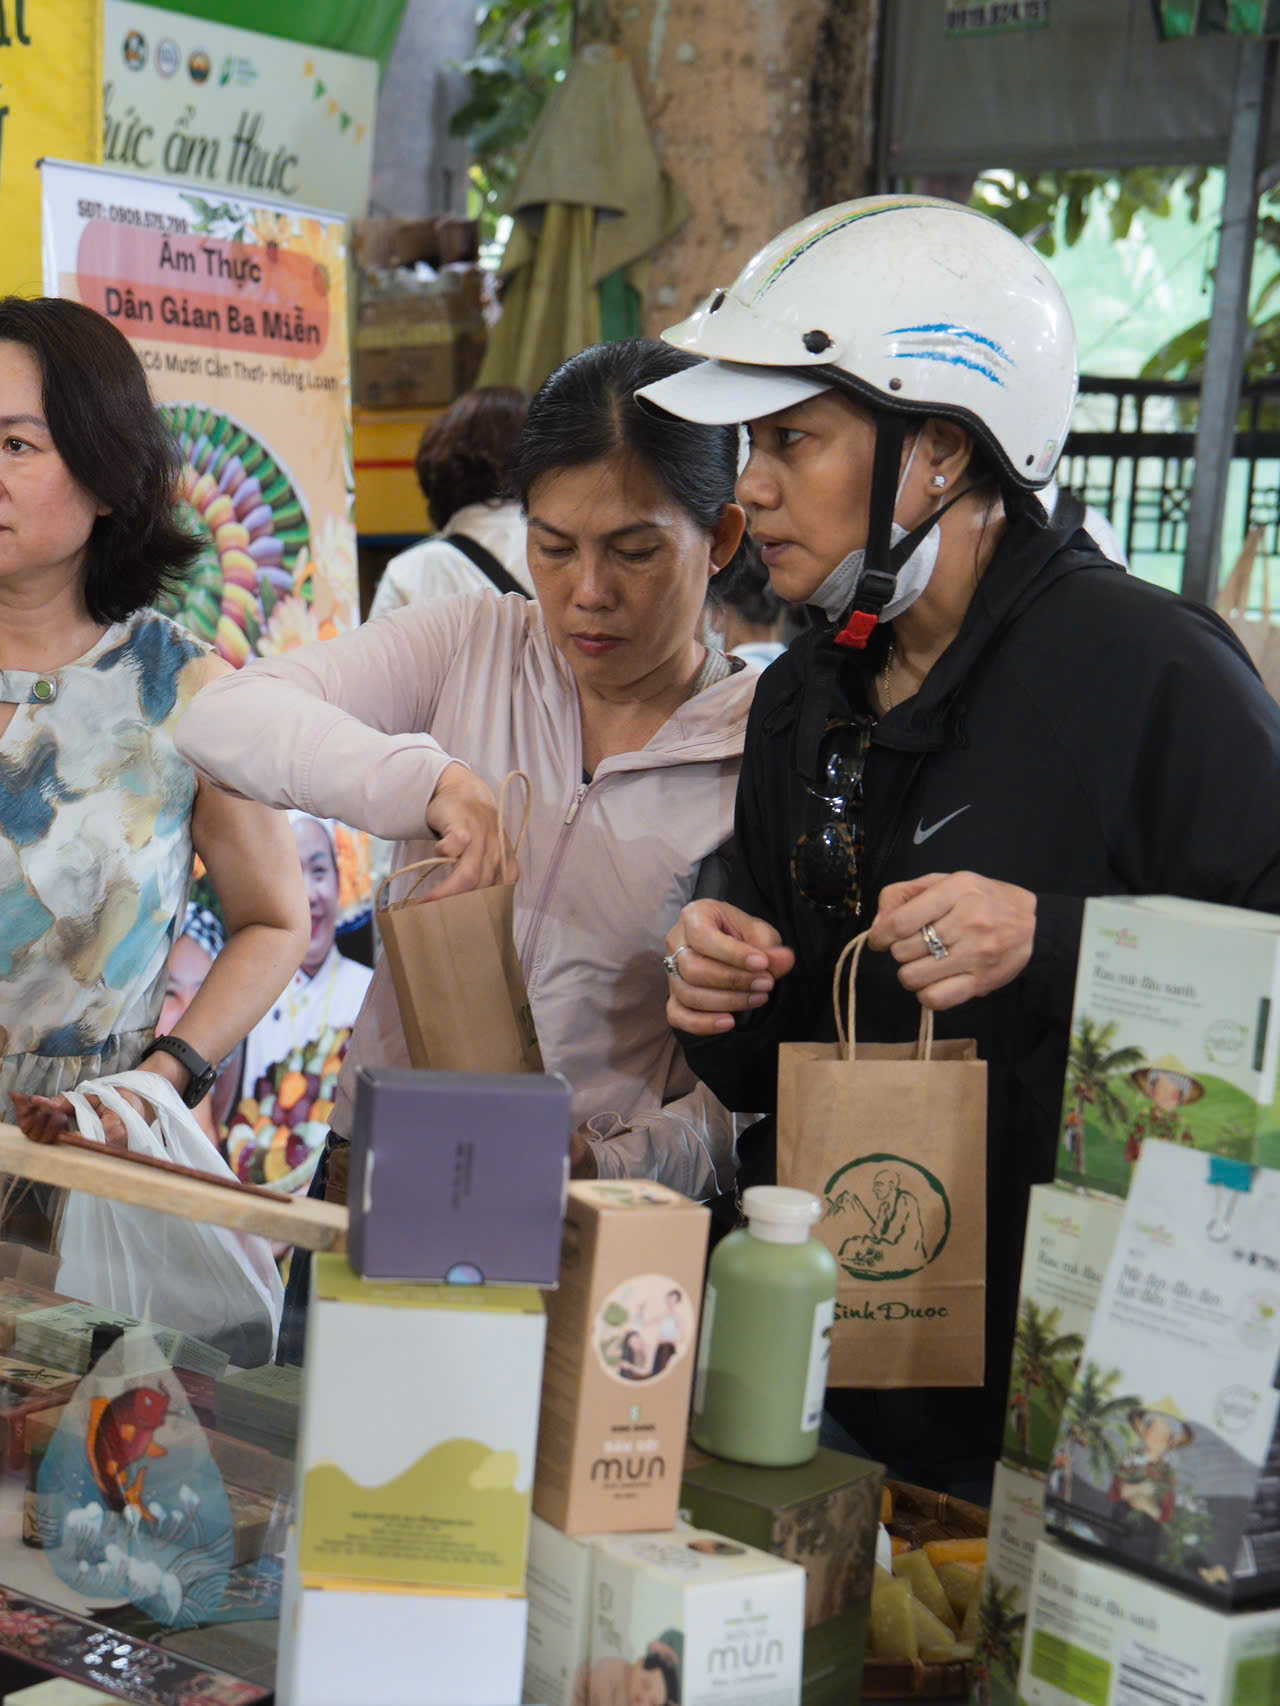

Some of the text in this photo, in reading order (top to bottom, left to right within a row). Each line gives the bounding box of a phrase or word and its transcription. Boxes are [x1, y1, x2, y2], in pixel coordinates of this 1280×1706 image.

[202, 248, 262, 289] Thực
[105, 288, 322, 345] Dân Gian Ba Miền
[590, 1455, 665, 1482] mun
[706, 1638, 783, 1674] mun
